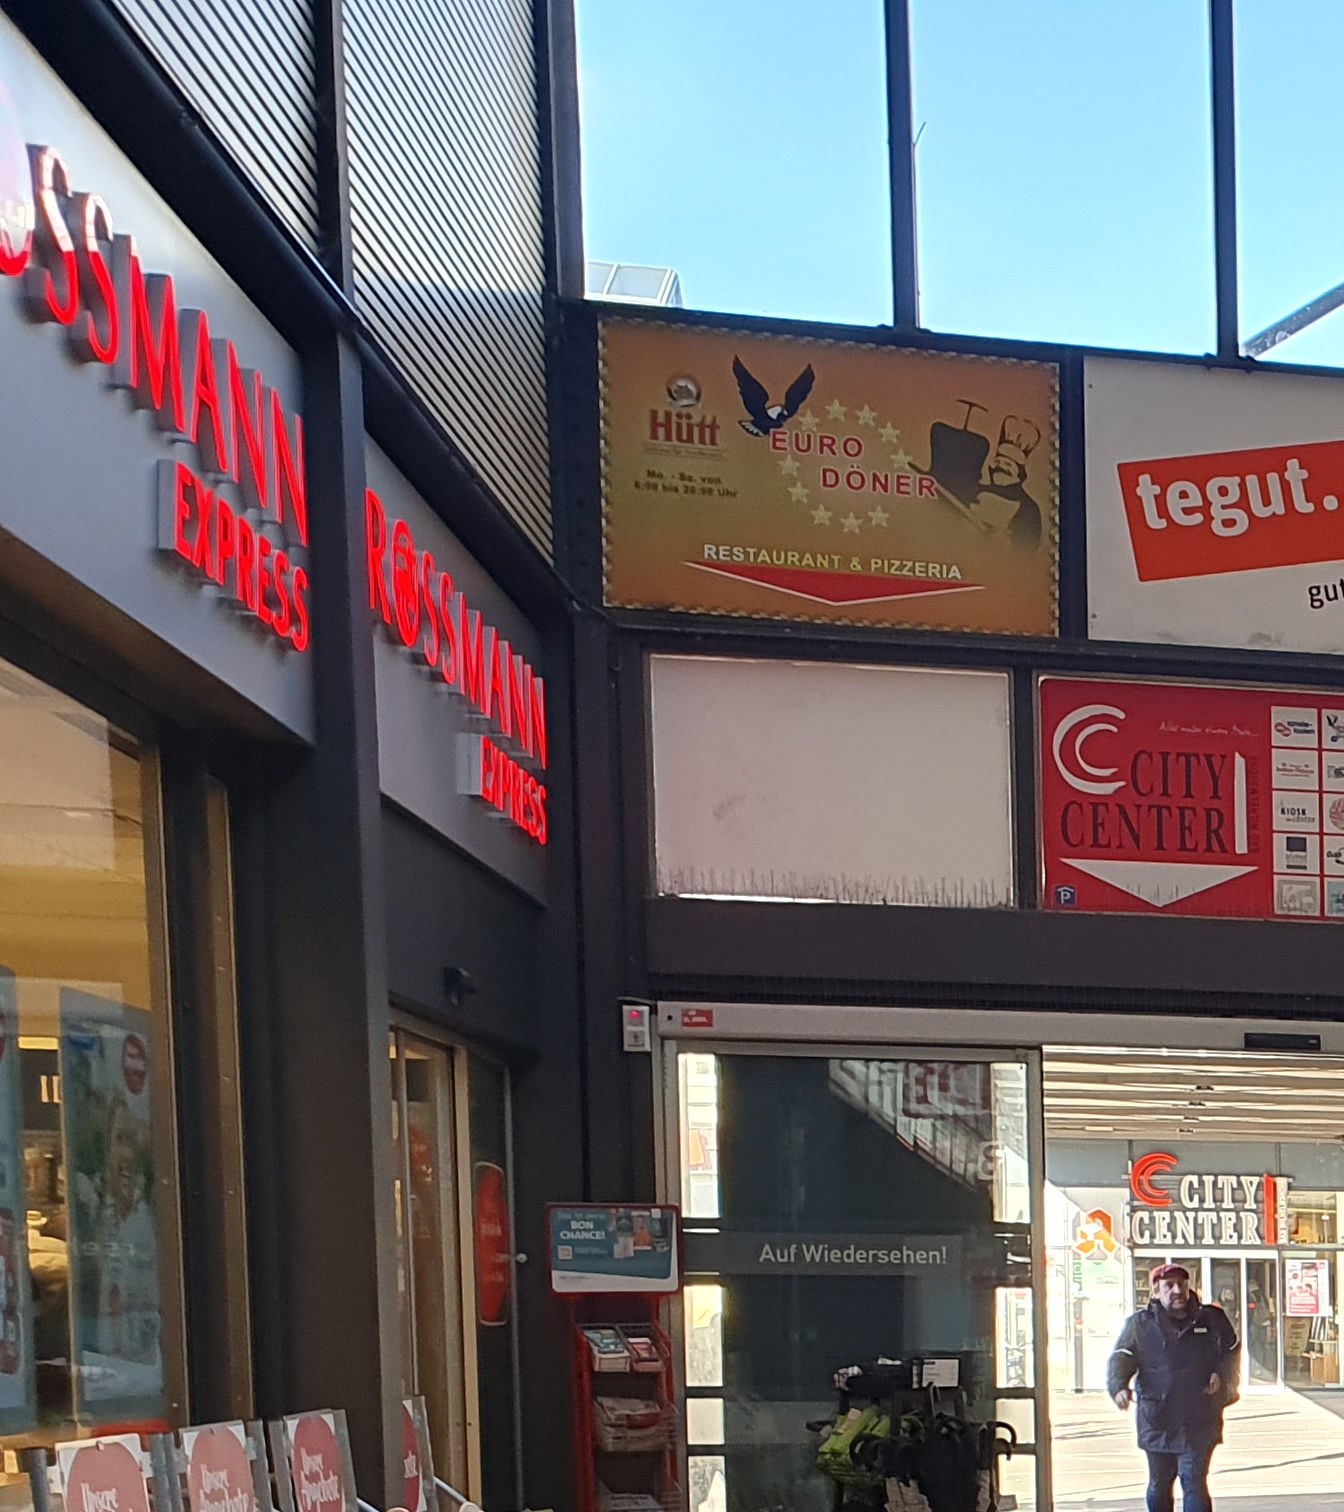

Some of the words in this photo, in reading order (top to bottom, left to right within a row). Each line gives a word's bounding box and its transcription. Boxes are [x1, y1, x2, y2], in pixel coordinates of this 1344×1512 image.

[648, 409, 721, 447] Hütt
[770, 428, 865, 458] EURO
[717, 487, 738, 499] Uhr
[821, 463, 938, 499] DÖNER
[173, 460, 310, 653] EXPRESS
[703, 544, 841, 571] RESTAURANT
[849, 556, 862, 571] &
[870, 558, 962, 580] PIZZERIA
[365, 487, 548, 771] ROSSMANN
[481, 735, 548, 846] EXPRESS
[1130, 749, 1228, 801] CITY
[1061, 800, 1228, 854] CENTER
[1280, 807, 1307, 816] KIOSK
[1180, 1174, 1260, 1210] CITY
[1131, 1211, 1262, 1246] CENTER
[760, 1243, 804, 1264] Auf
[805, 1243, 947, 1265] Wiedersehen!
